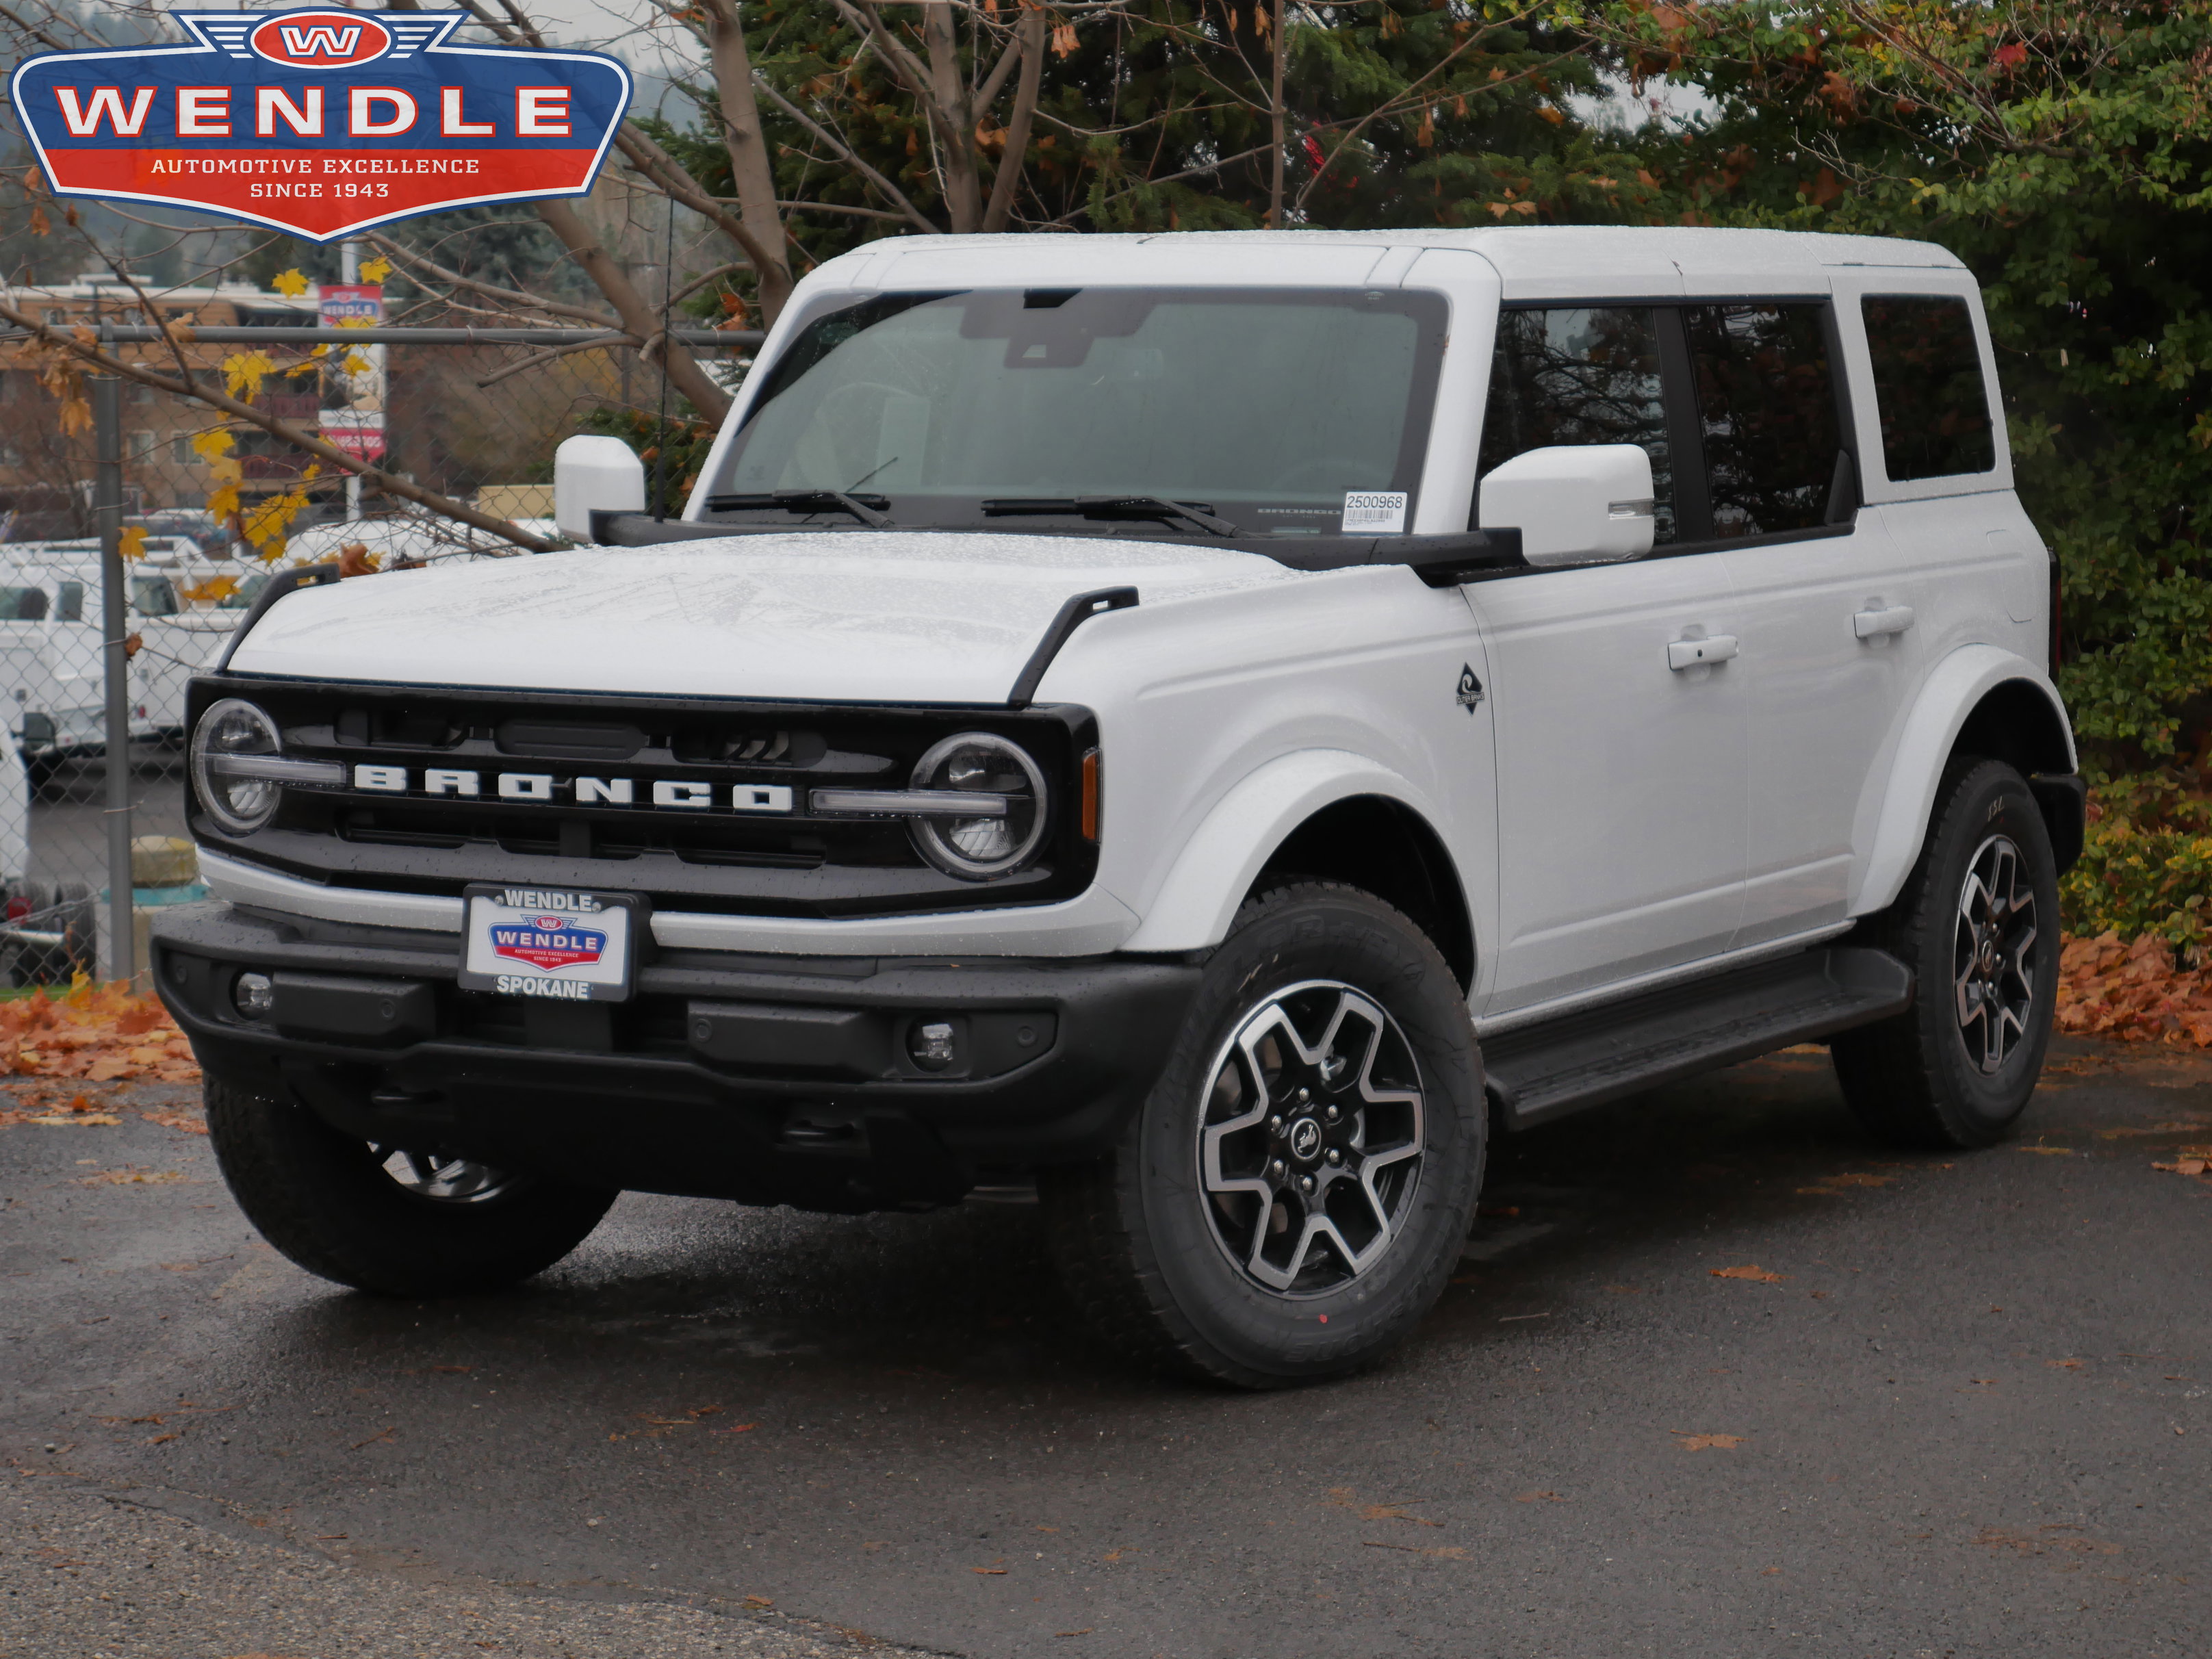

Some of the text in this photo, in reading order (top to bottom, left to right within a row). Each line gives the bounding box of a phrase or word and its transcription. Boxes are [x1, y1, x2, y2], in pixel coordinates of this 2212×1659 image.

[322, 305, 372, 315] WENDLE
[1347, 496, 1402, 509] 2500968
[355, 764, 793, 812] BRONCO
[504, 889, 593, 912] WENDLE
[497, 931, 597, 950] WENDLE
[497, 975, 589, 999] SPOKANE
